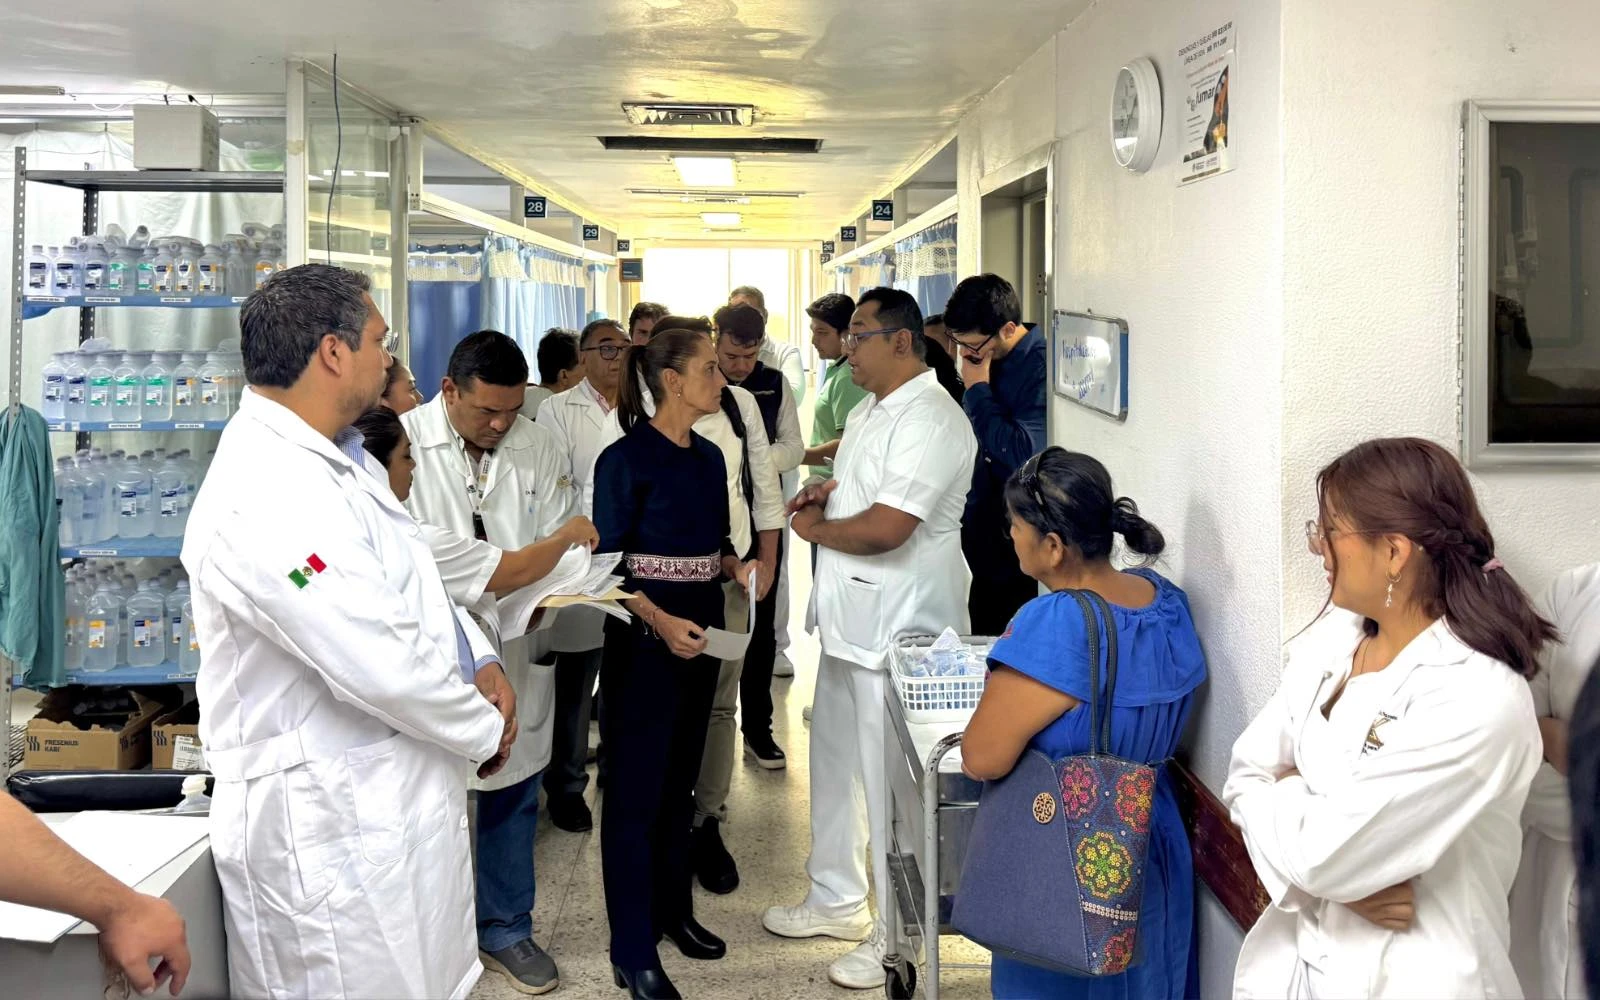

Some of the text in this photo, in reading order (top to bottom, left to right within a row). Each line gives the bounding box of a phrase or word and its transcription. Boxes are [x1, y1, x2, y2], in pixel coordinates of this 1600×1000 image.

[527, 201, 544, 213] 28
[875, 204, 892, 216] 24
[585, 228, 598, 237] 29
[842, 230, 855, 239] 25
